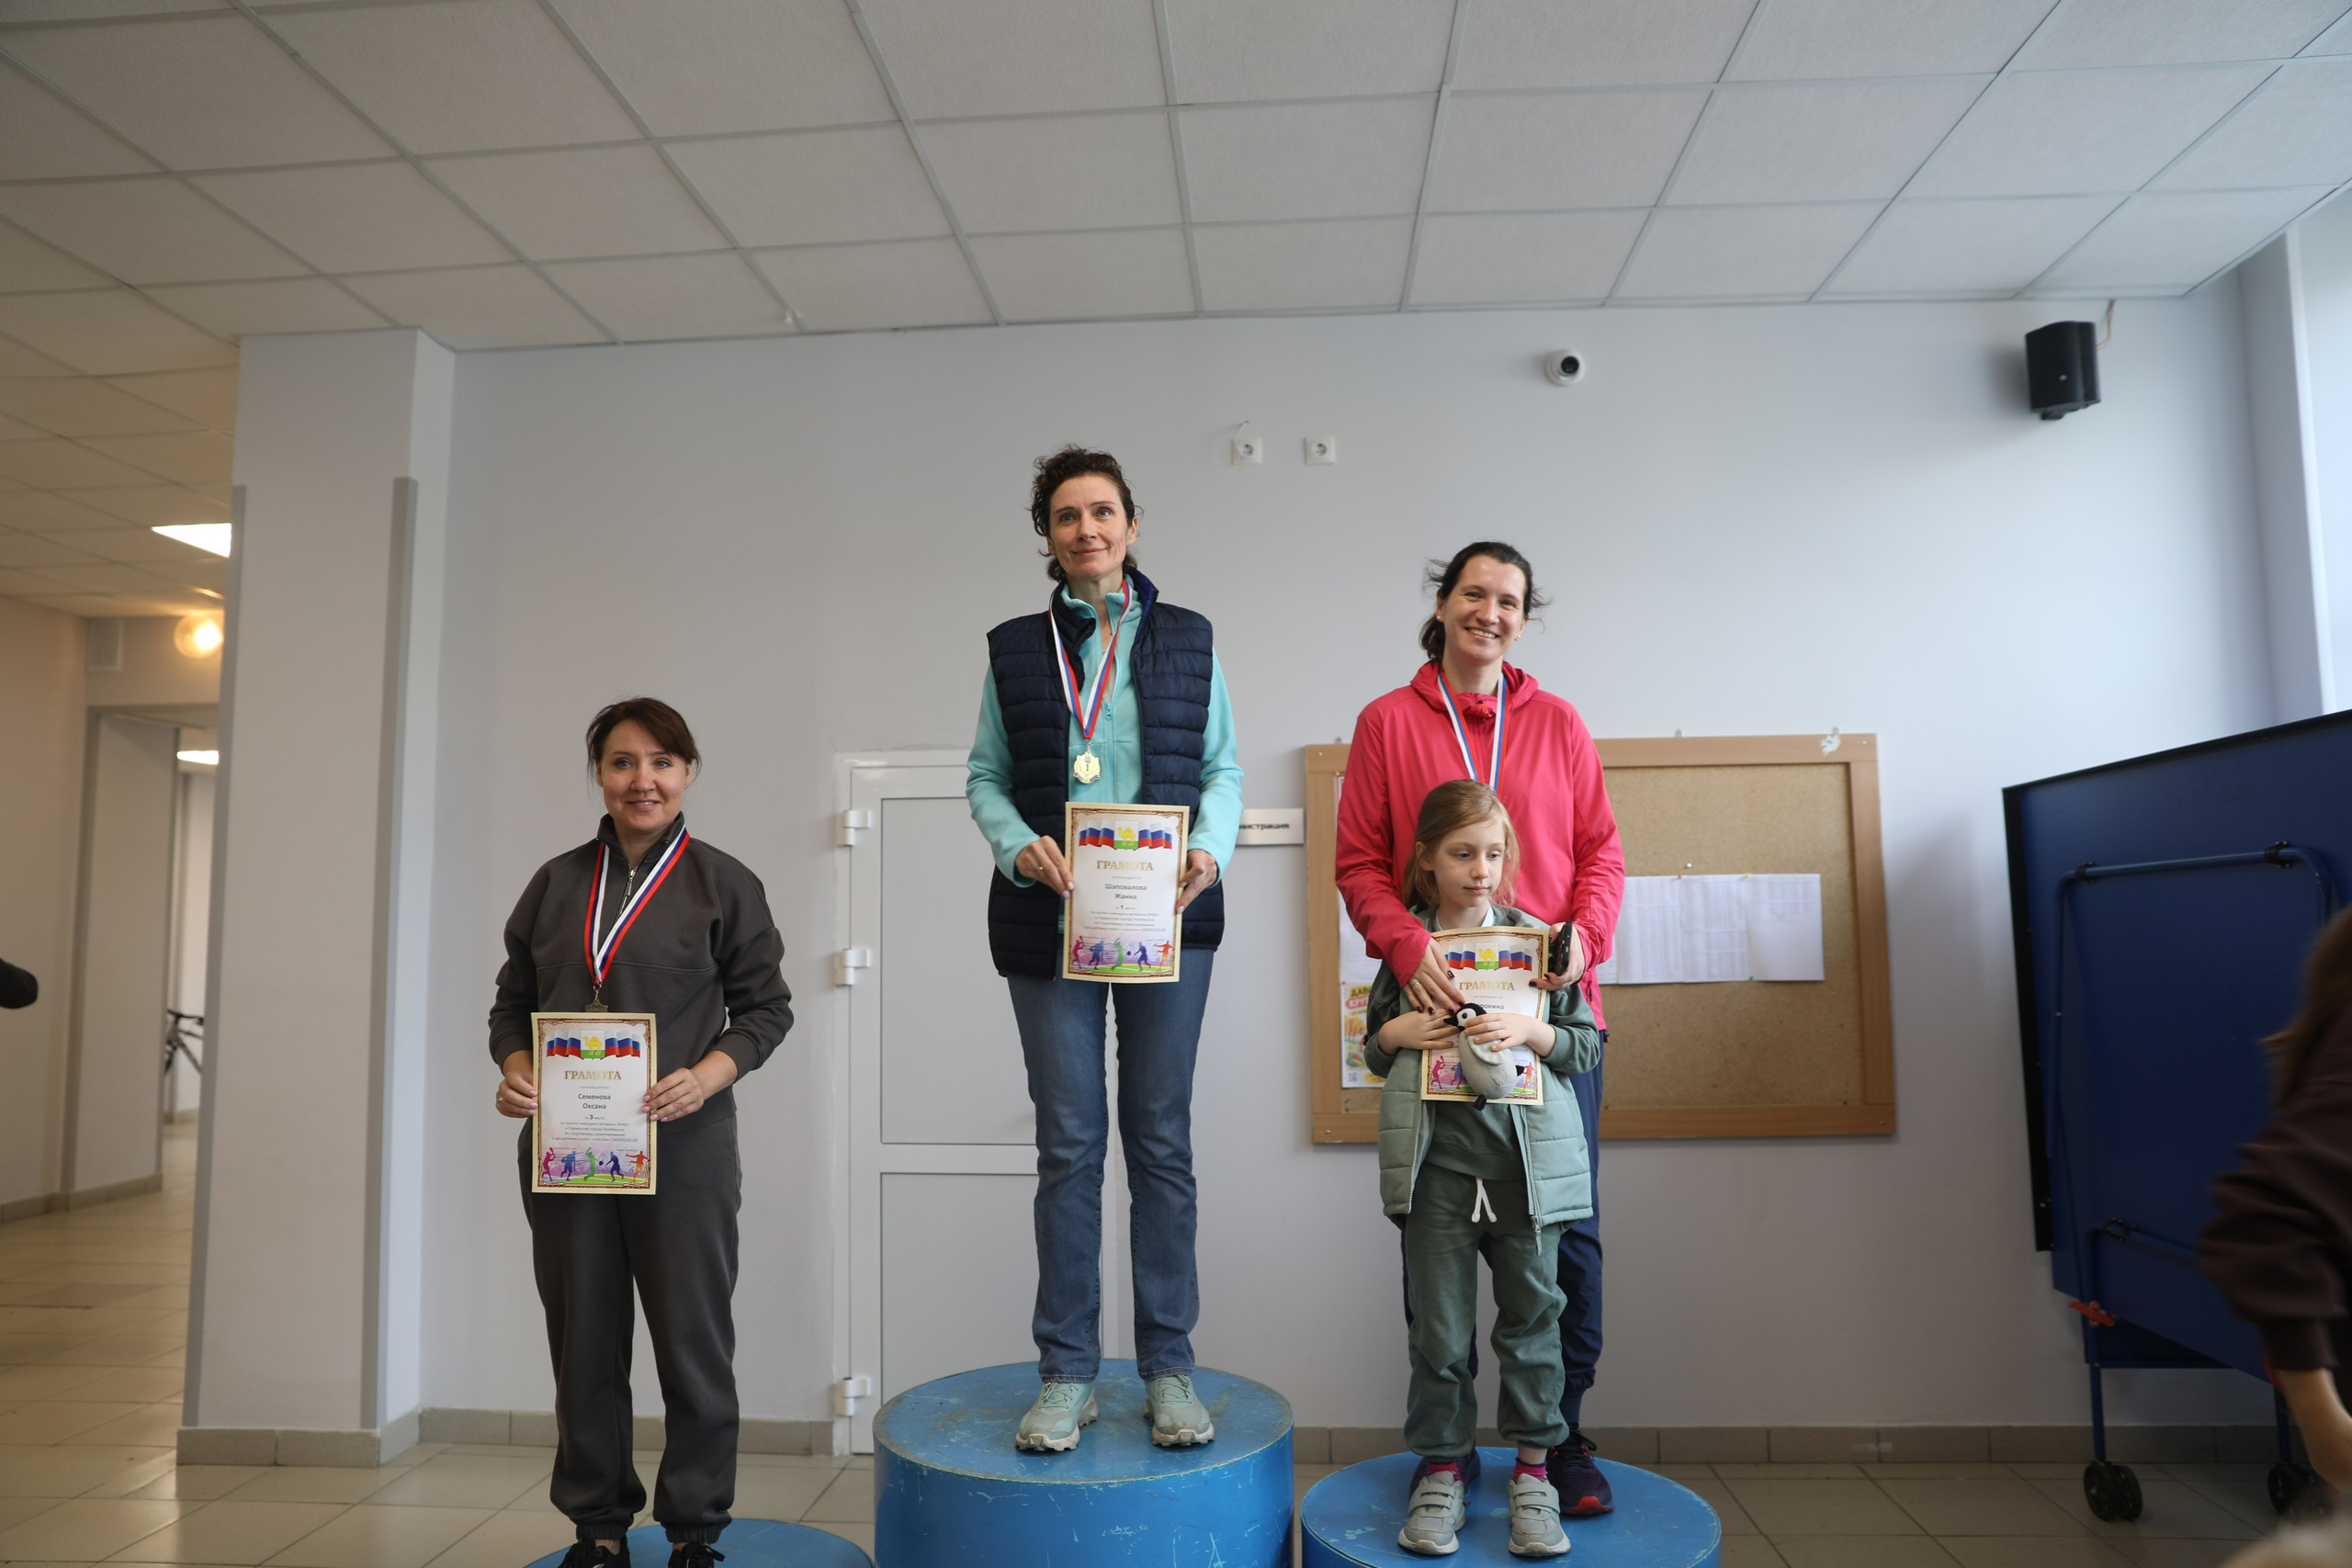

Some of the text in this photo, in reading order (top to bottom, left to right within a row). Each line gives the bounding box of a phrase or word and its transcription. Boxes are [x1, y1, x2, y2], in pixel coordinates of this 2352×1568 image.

[1096, 860, 1154, 871] ГРАМОТА
[1459, 981, 1515, 991] ГРАМОТА
[564, 1070, 622, 1080] ГРАМОТА
